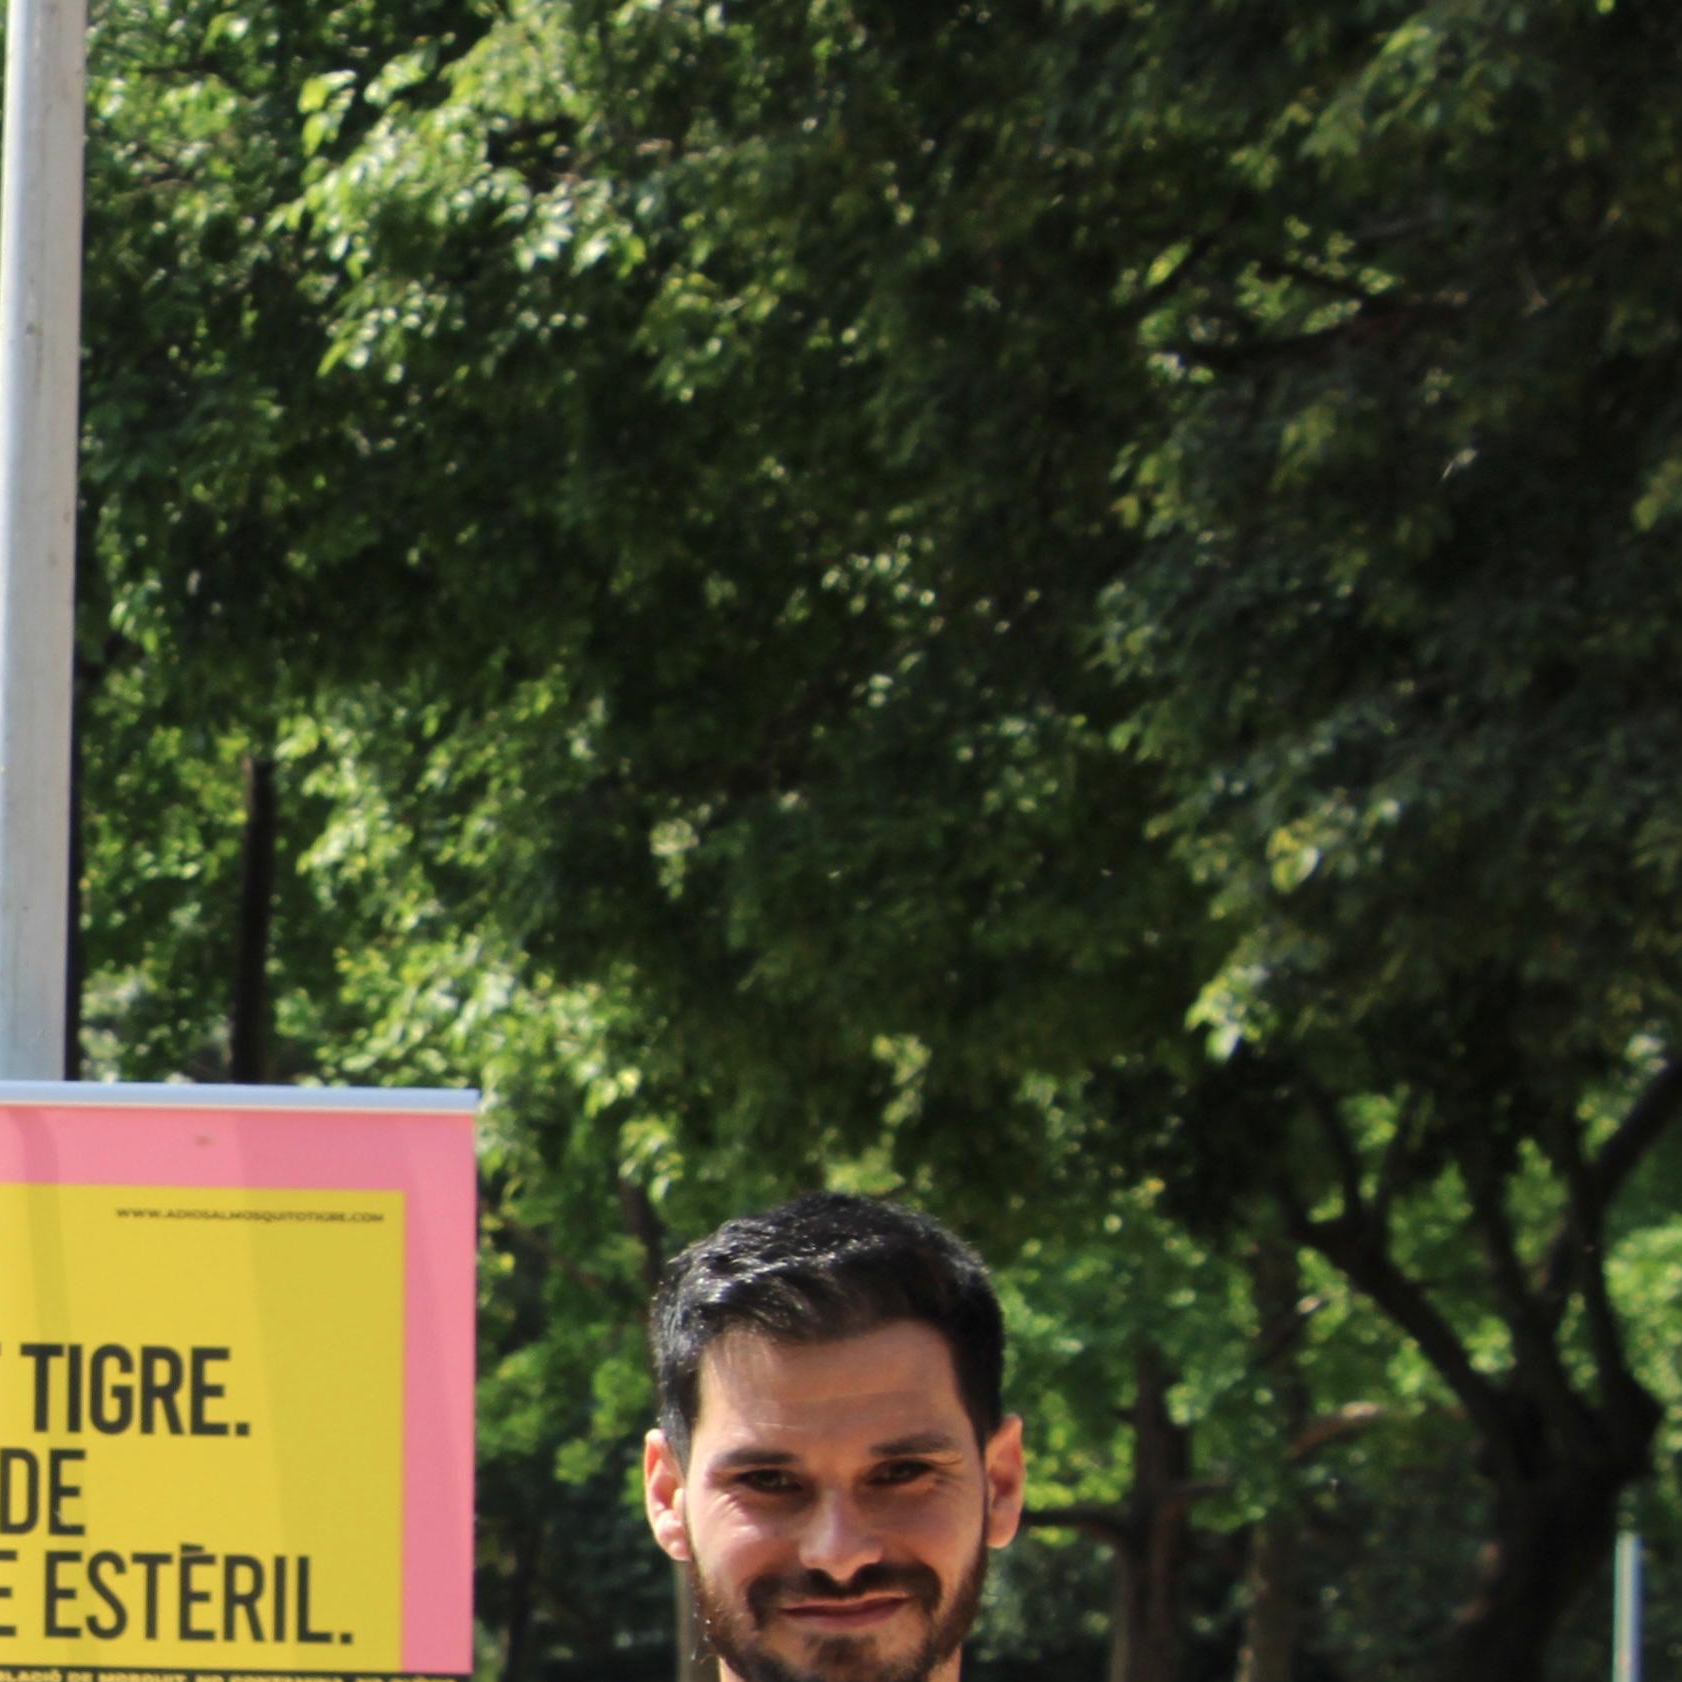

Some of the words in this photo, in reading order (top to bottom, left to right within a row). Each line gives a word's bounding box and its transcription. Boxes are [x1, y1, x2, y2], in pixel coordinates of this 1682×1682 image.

[115, 1208, 385, 1223] WWW.ADIOSALMOSQUITOTIGRE.COM
[20, 1343, 251, 1438] TIGRE.
[43, 1543, 355, 1645] ESTÈRIL.
